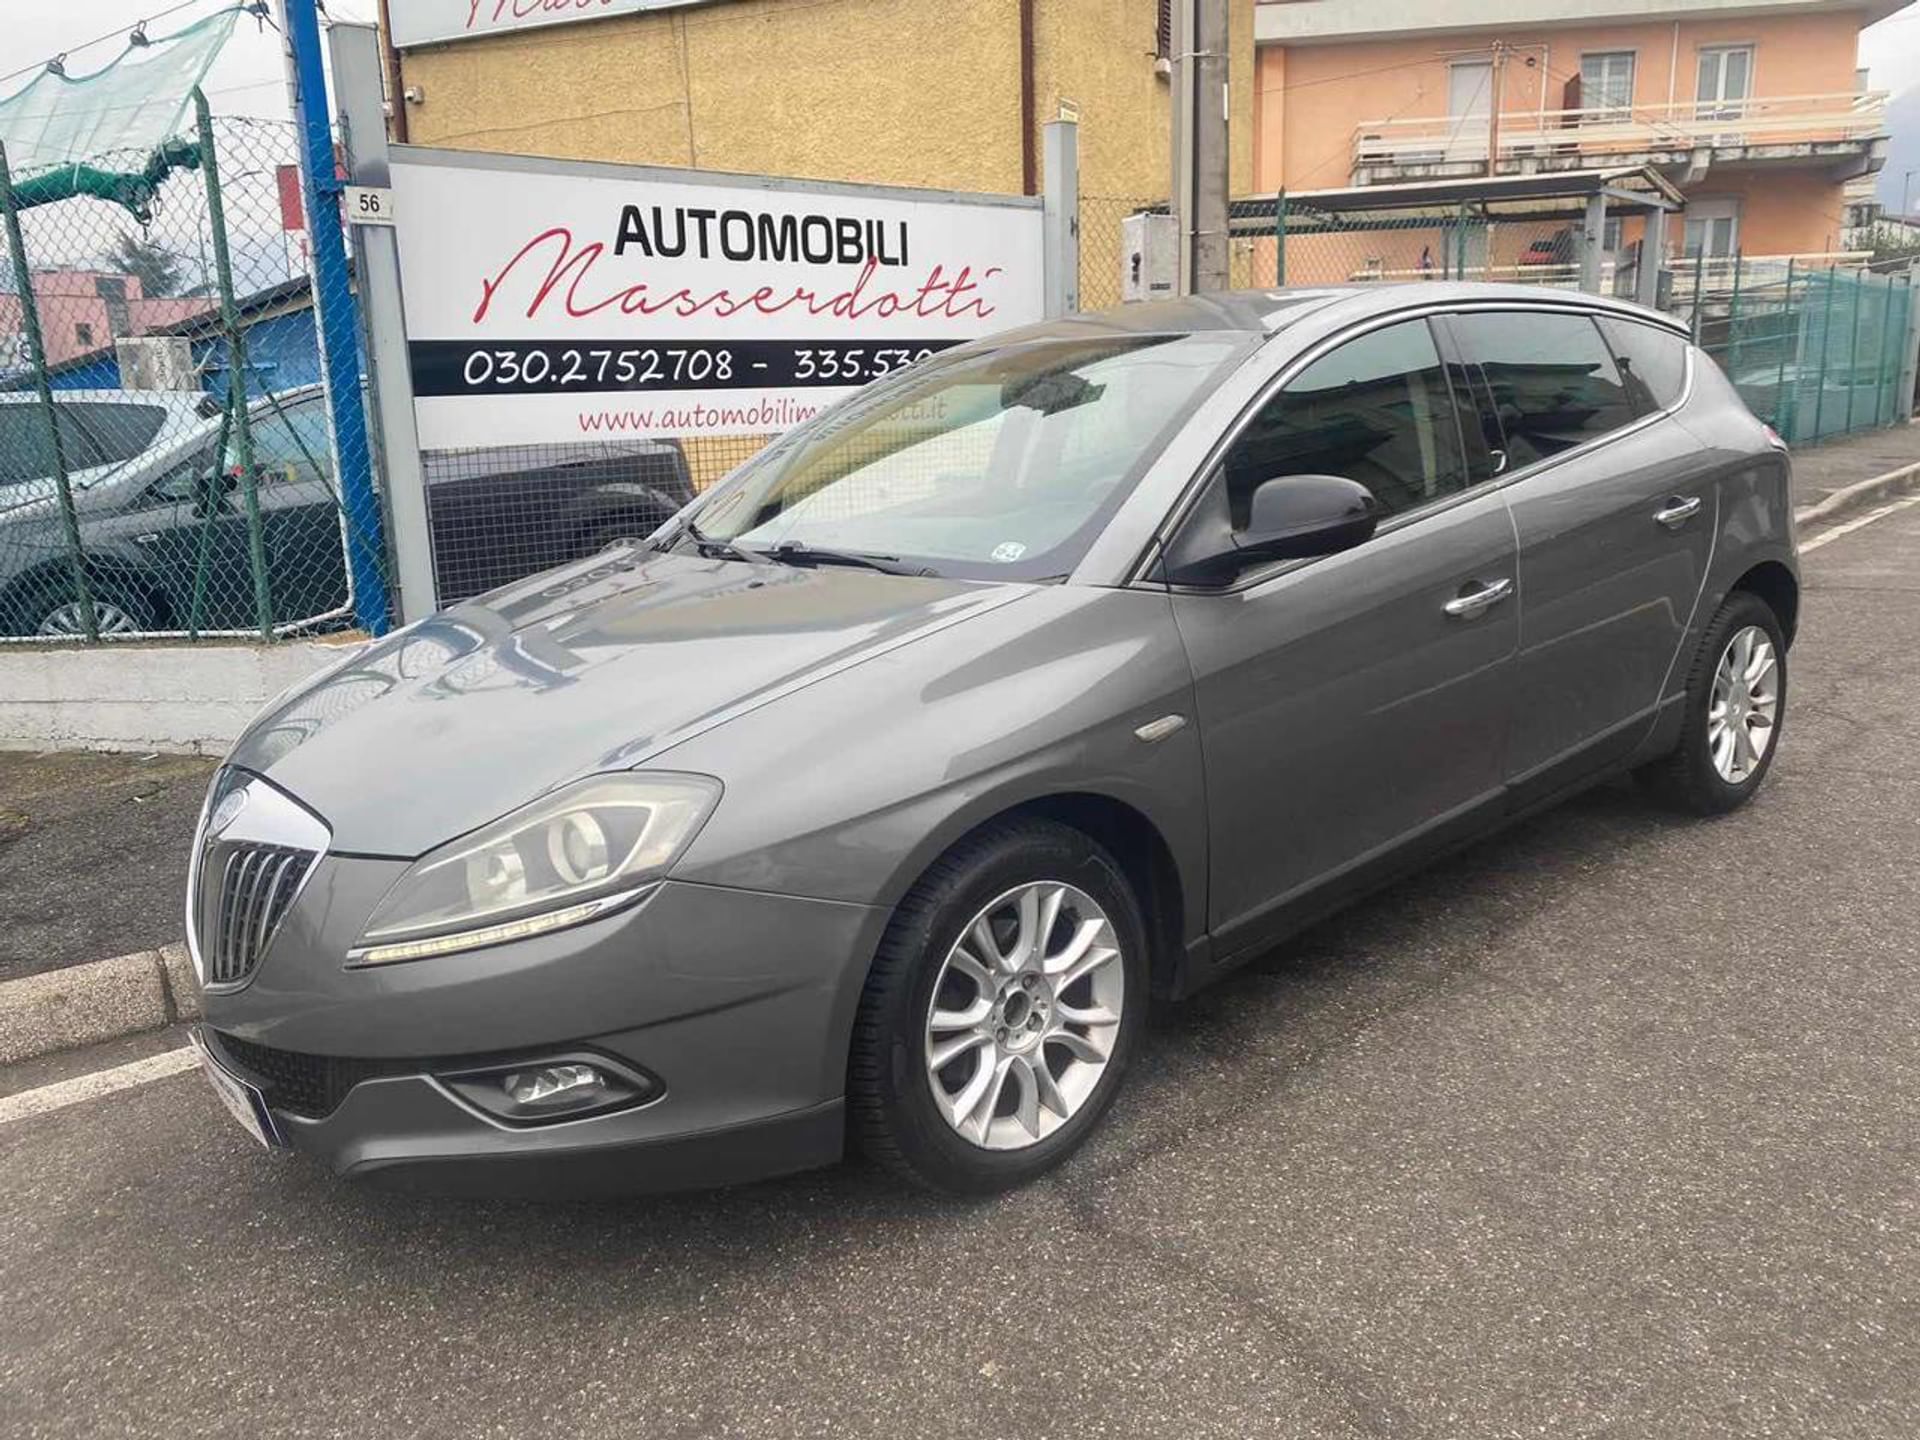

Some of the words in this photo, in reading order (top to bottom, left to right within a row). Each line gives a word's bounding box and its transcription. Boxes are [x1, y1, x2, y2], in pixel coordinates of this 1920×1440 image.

[360, 194, 380, 212] 56
[614, 204, 908, 266] AUTOMOBILI
[473, 228, 1002, 323] Masserdotti
[463, 350, 733, 384] 030.2752708
